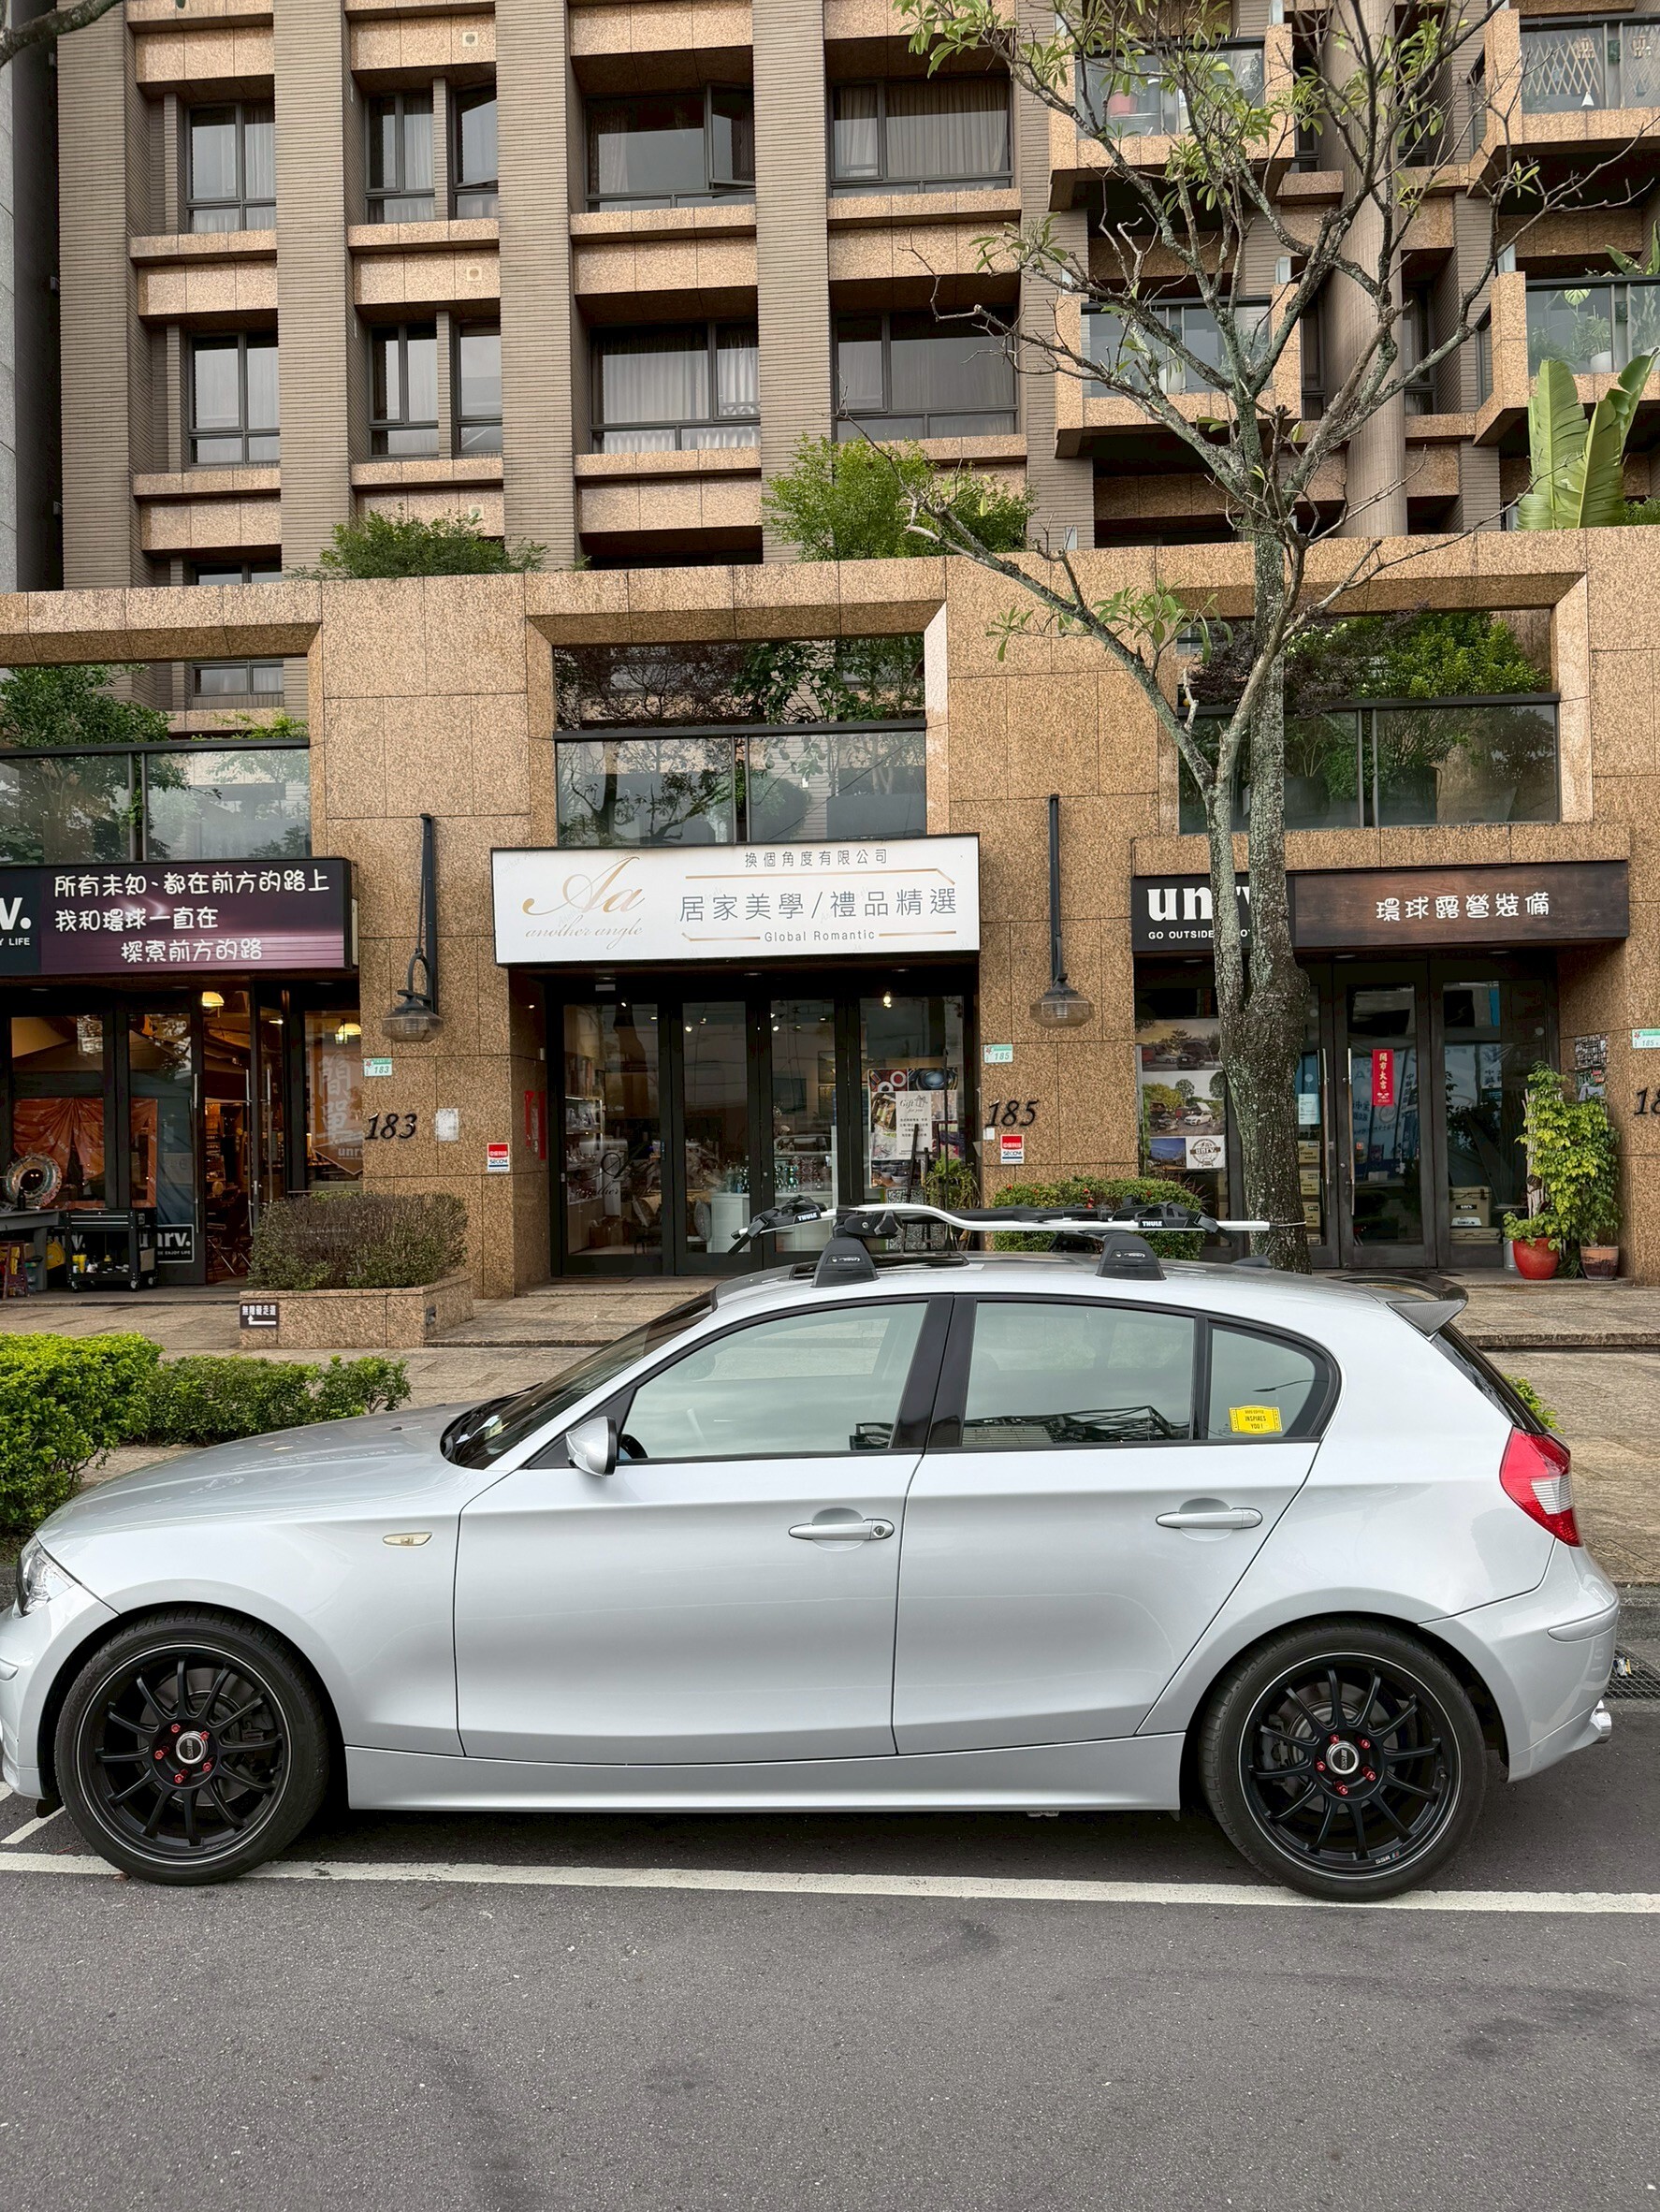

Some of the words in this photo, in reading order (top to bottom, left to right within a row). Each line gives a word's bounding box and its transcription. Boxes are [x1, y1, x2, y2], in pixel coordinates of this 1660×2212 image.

[745, 849, 888, 867] 換個角度有限公司
[54, 868, 330, 897] 所有未知、都在前方的路上
[522, 855, 645, 916] Aa
[679, 888, 957, 923] 居家美學/禮品精選
[1376, 892, 1550, 922] 環球露營裝備
[54, 906, 219, 933] 我和環球一直在
[525, 914, 592, 938] another
[594, 918, 643, 950] angle
[8, 937, 30, 946] LIFE
[764, 931, 807, 942] Global
[813, 929, 875, 940] Romantic
[1148, 931, 1164, 939] GO
[1169, 929, 1214, 939] OUTSIDE
[121, 938, 263, 963] 探索前方的路
[995, 1052, 1010, 1060] 185
[373, 1065, 389, 1074] 183
[365, 1112, 418, 1140] 183
[985, 1099, 1040, 1127] 185
[797, 1213, 818, 1222] THULE
